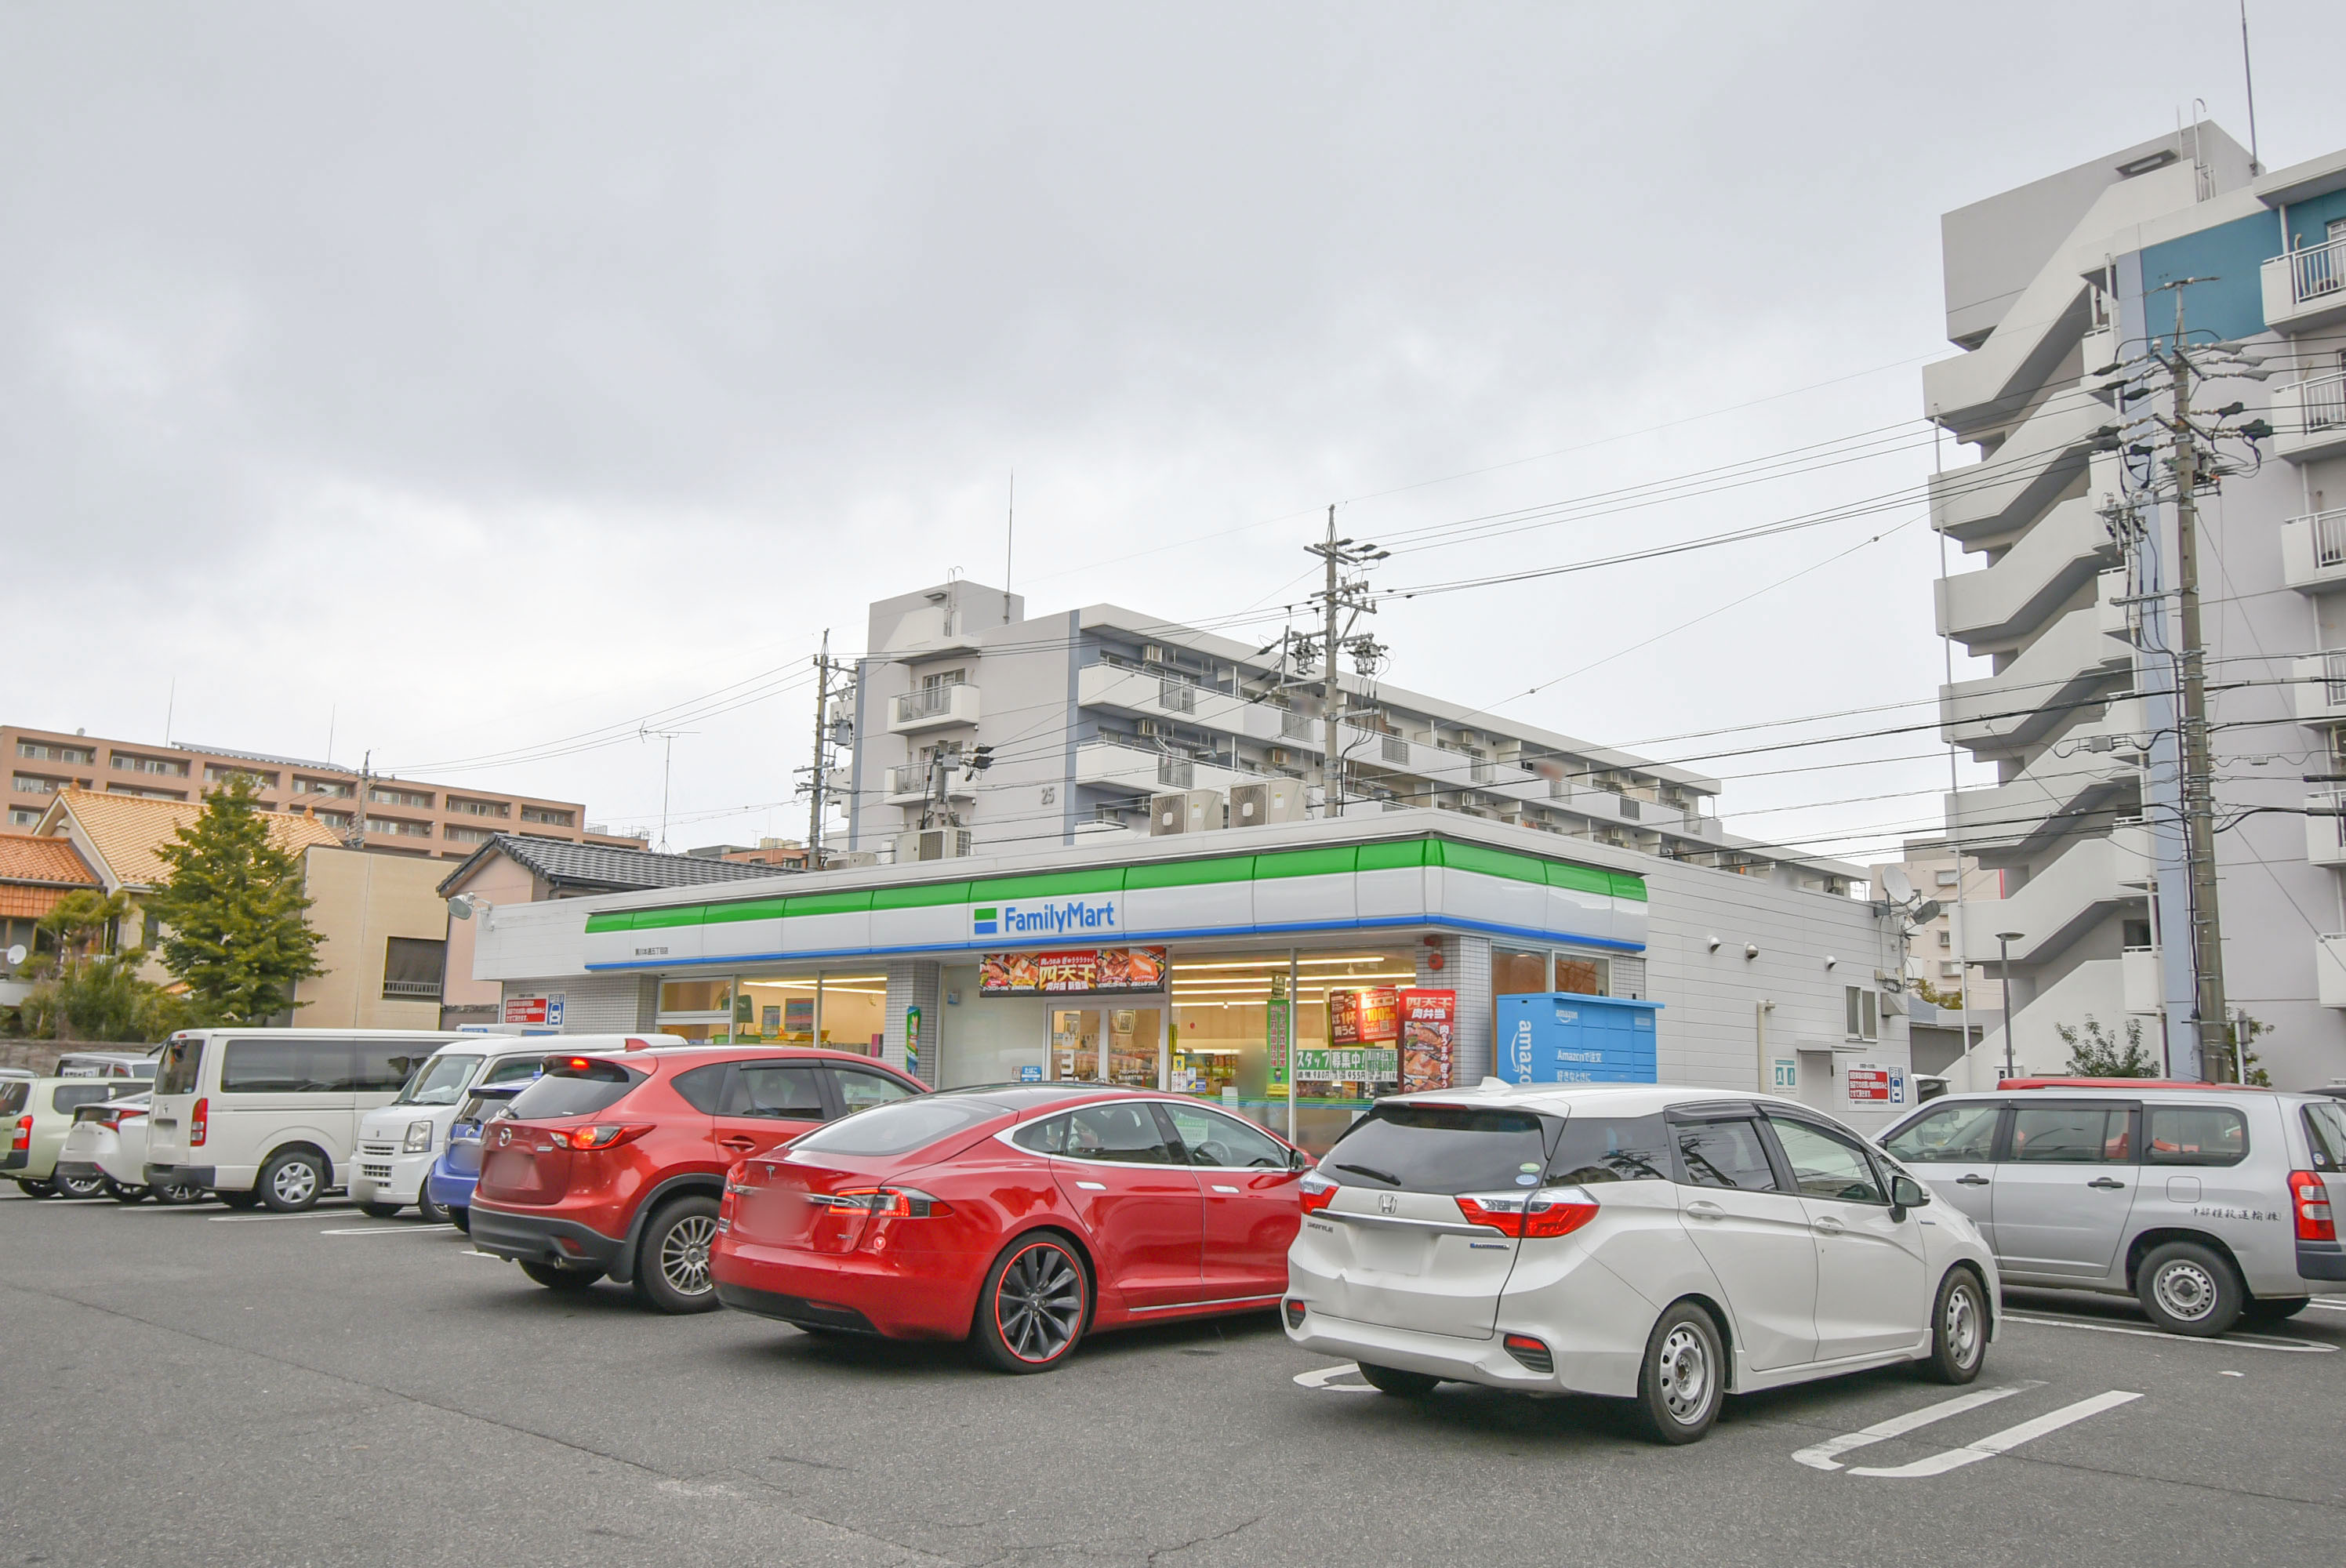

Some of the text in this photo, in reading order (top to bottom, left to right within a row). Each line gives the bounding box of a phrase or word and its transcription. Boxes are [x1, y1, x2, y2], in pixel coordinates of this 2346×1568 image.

[1041, 786, 1055, 804] 25
[1005, 902, 1115, 933] FamilyMart
[1039, 963, 1097, 989] 四天王
[1045, 981, 1067, 991] 肉弁当
[1406, 996, 1454, 1011] 四天王
[1411, 1007, 1446, 1019] 肉弁当
[1556, 1009, 1578, 1019] amazon
[1297, 1051, 1330, 1068] スタッフ
[1331, 1051, 1365, 1069] 募集中!
